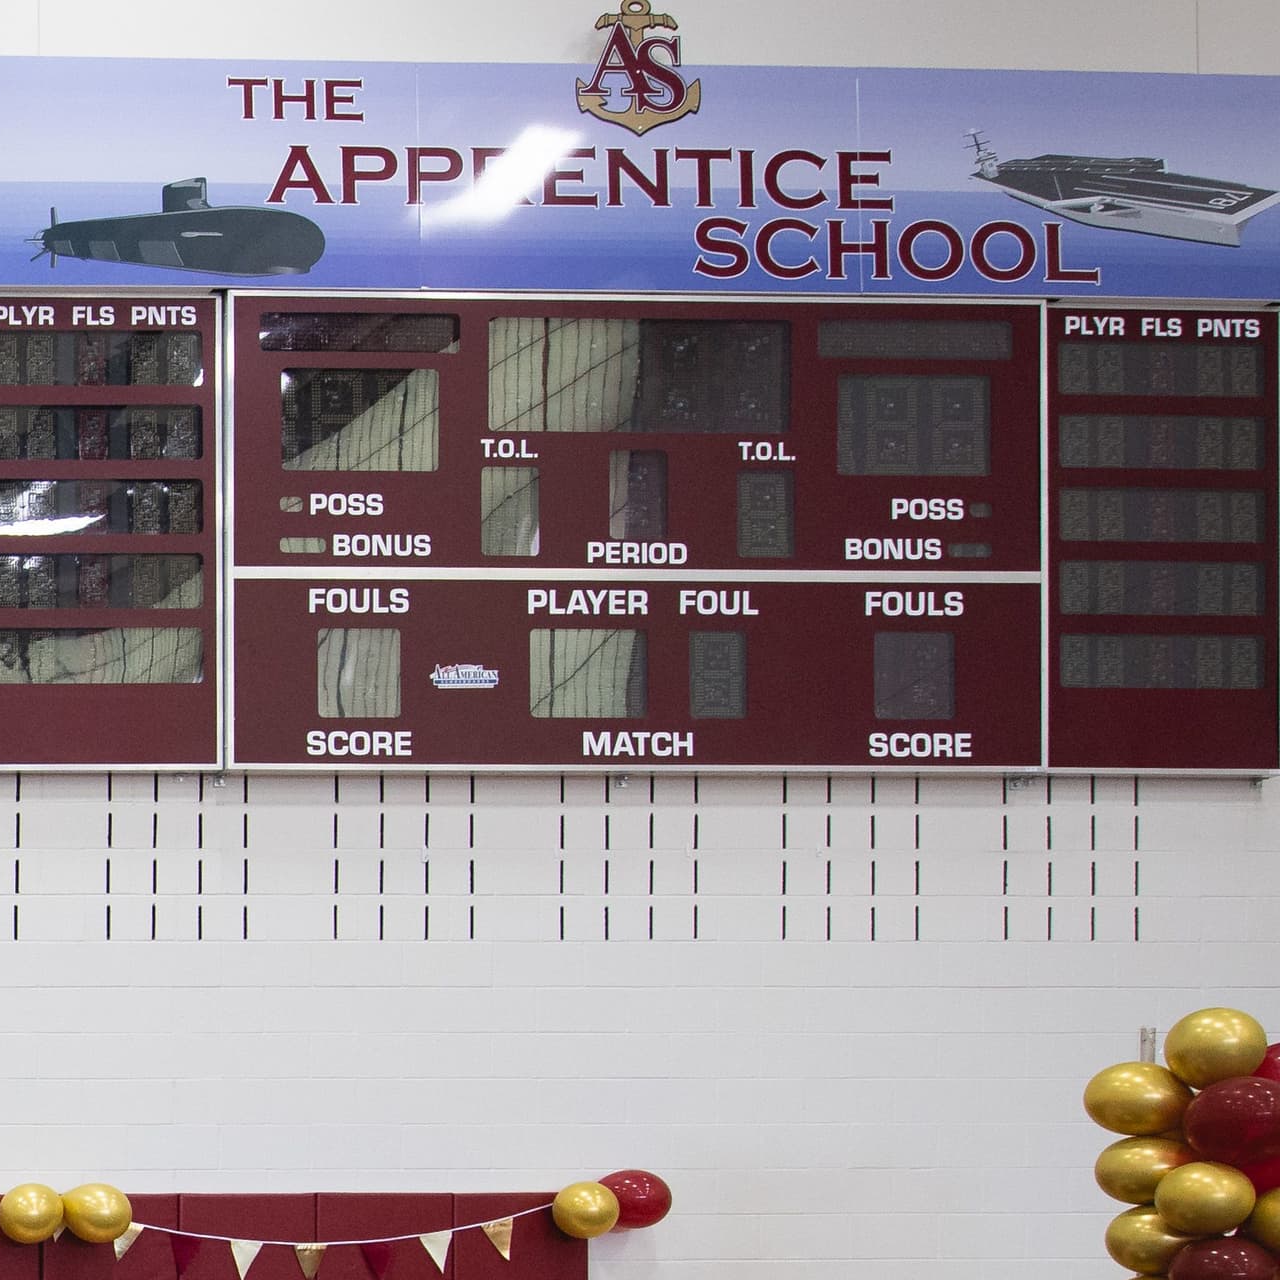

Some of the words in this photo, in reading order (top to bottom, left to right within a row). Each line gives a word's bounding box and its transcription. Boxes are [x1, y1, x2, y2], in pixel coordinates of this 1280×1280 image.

[578, 21, 687, 114] AS
[226, 75, 365, 123] THE
[692, 216, 1102, 287] SCHOOL
[72, 305, 115, 326] FLS
[131, 305, 197, 326] PNTS
[1065, 315, 1125, 336] PLYR
[1141, 317, 1182, 337] FLS
[1197, 318, 1260, 338] PNTS
[480, 438, 539, 459] T.O.L.
[738, 441, 796, 461] T.O.L.
[310, 493, 384, 516] POSS
[891, 498, 964, 521] POSS
[332, 533, 432, 557] BONUS
[587, 541, 688, 565] PERIOD
[845, 538, 942, 560] BONUS
[308, 587, 410, 614] FOULS
[527, 589, 649, 615] PLAYER
[679, 590, 759, 616] FOUL
[865, 591, 964, 617] FOULS
[306, 730, 413, 756] SCORE
[582, 731, 694, 757] MATCH
[868, 732, 972, 758] SCORE
